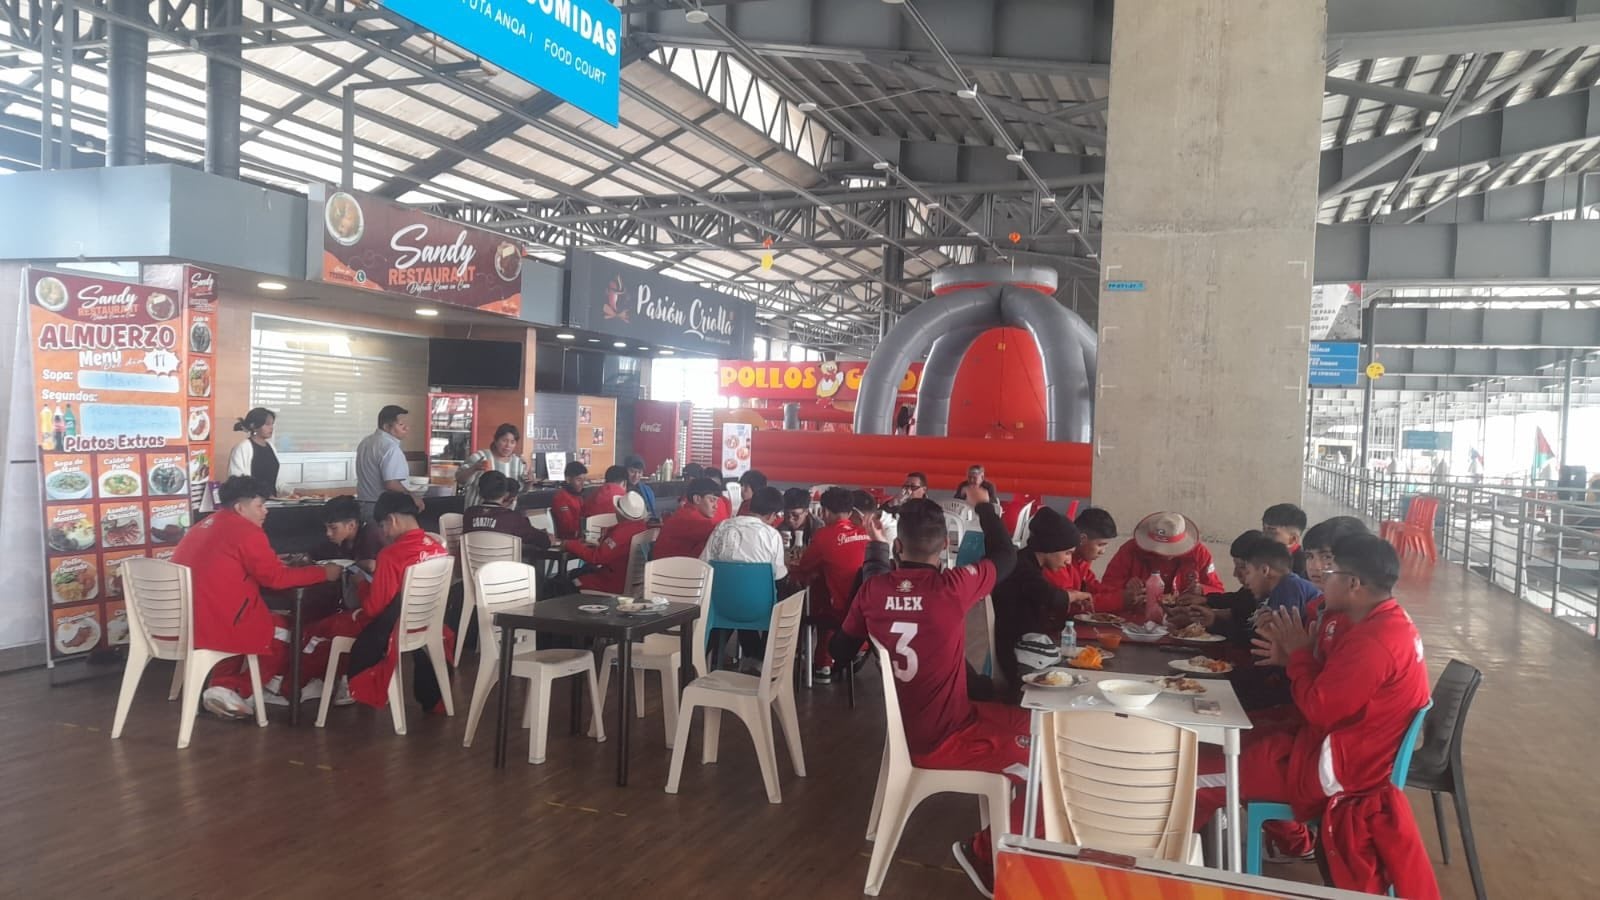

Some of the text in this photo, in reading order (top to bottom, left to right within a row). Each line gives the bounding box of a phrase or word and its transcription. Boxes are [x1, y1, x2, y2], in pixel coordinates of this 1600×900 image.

[527, 0, 617, 56] OMIDAS
[495, 12, 527, 38] ANQA
[544, 38, 573, 66] FOOD
[574, 57, 607, 86] COURT
[390, 224, 476, 277] Sandy
[388, 266, 476, 286] RESTAURANT
[78, 285, 138, 310] Sandy
[636, 284, 734, 339] Pasión Criolla
[39, 324, 176, 349] ALMUERZO
[42, 369, 73, 381] Sopa:
[720, 366, 816, 389] POLLOS
[41, 389, 98, 403] Segundos:
[64, 434, 165, 452] Platos Extras
[885, 596, 923, 611] ALEX
[889, 622, 919, 683] 3
